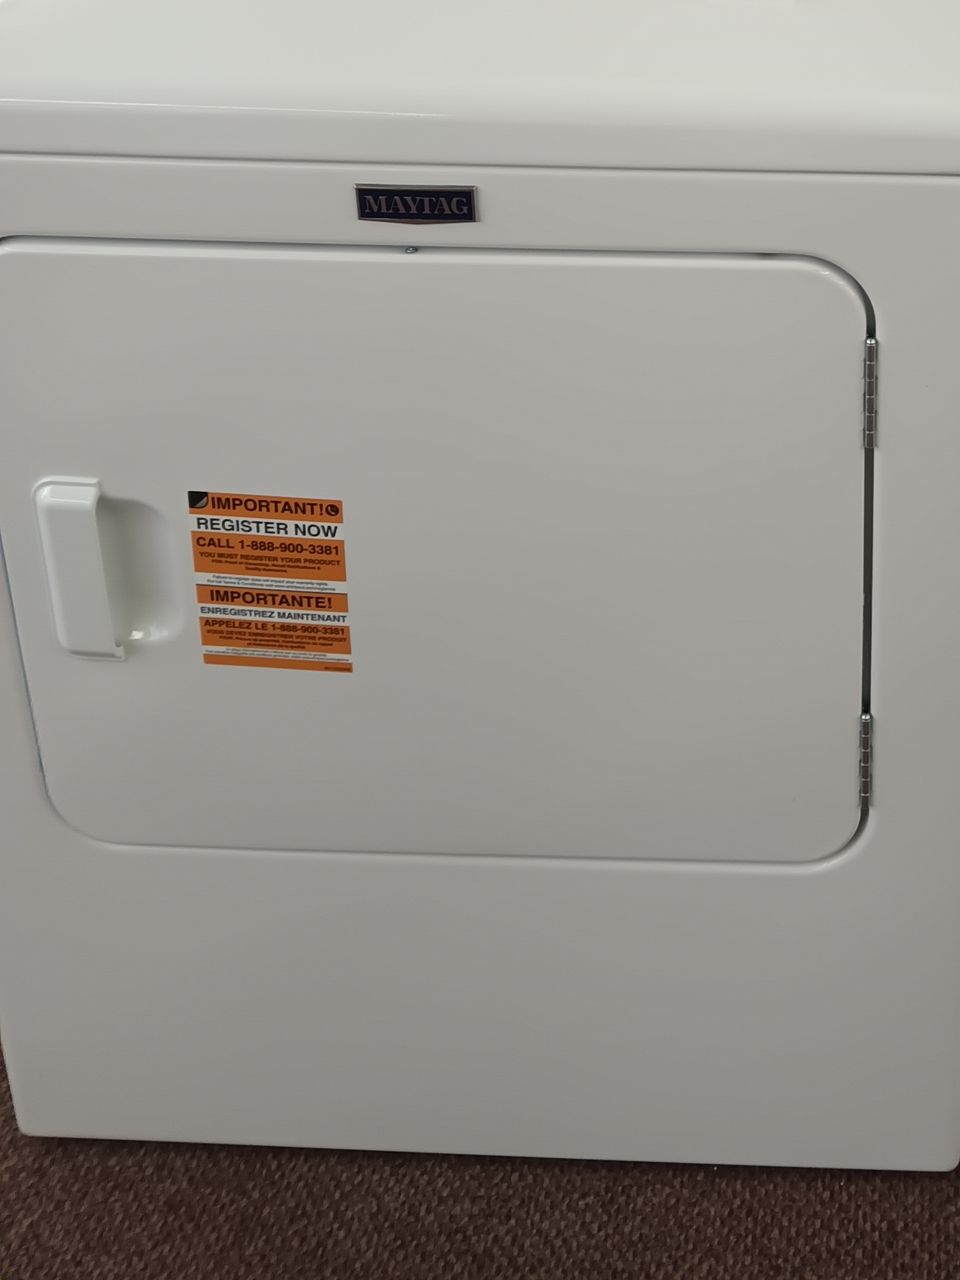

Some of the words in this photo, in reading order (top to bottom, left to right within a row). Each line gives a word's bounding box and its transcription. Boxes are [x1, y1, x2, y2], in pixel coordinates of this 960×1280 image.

[363, 195, 469, 215] MAYTAG
[211, 497, 323, 515] IMPORTANT!
[196, 517, 288, 535] REGISTER
[294, 523, 338, 538] NOW
[196, 536, 234, 549] CALL
[239, 540, 339, 556] 1-888-900-3381
[240, 554, 278, 562] REGISTER
[210, 589, 332, 609] IMPORTANTE!
[200, 606, 275, 618] ENREGISTREZ
[277, 612, 347, 623] MAINTENANT
[204, 619, 252, 630] APPELEZ
[255, 622, 268, 631] LE
[271, 623, 345, 636] 1-888-900-3381
